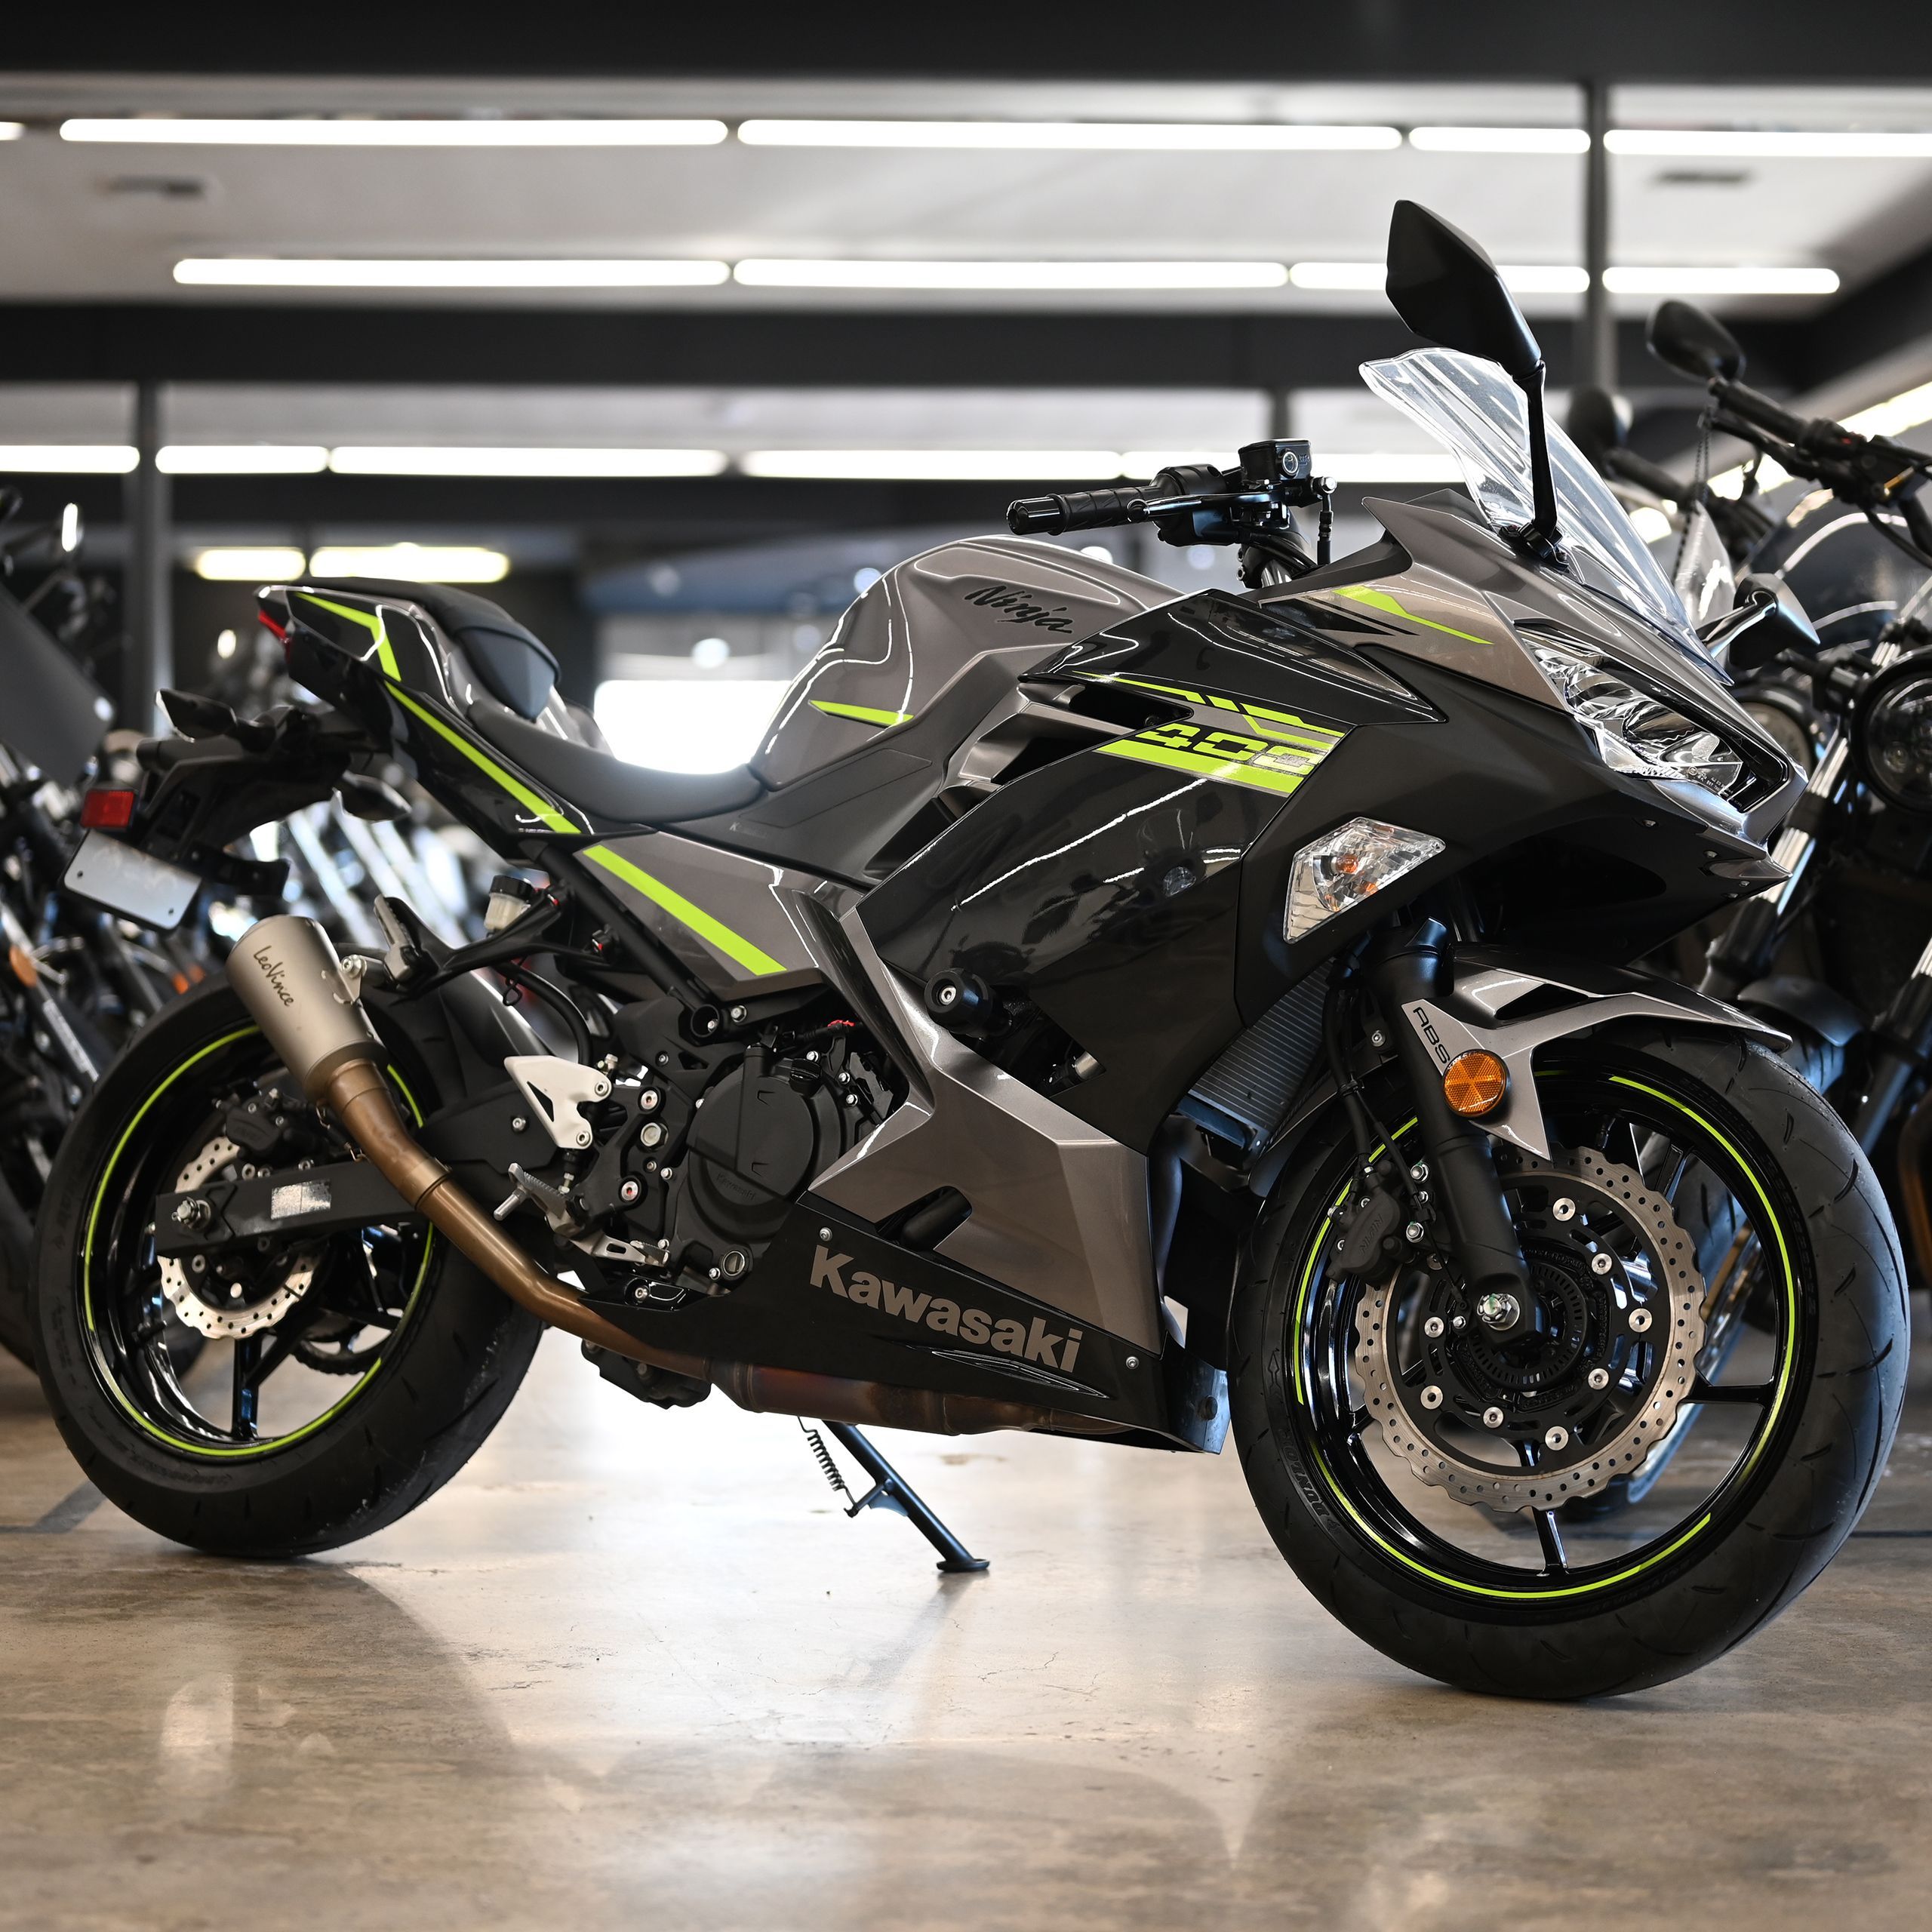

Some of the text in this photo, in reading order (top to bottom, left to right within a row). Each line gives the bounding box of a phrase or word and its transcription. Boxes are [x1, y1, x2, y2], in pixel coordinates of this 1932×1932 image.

[964, 585, 1073, 634] Ninja
[1135, 722, 1327, 775] 400
[253, 945, 294, 1008] LeoVince
[1413, 1006, 1451, 1064] ABS
[810, 1244, 1083, 1373] Kawasaki
